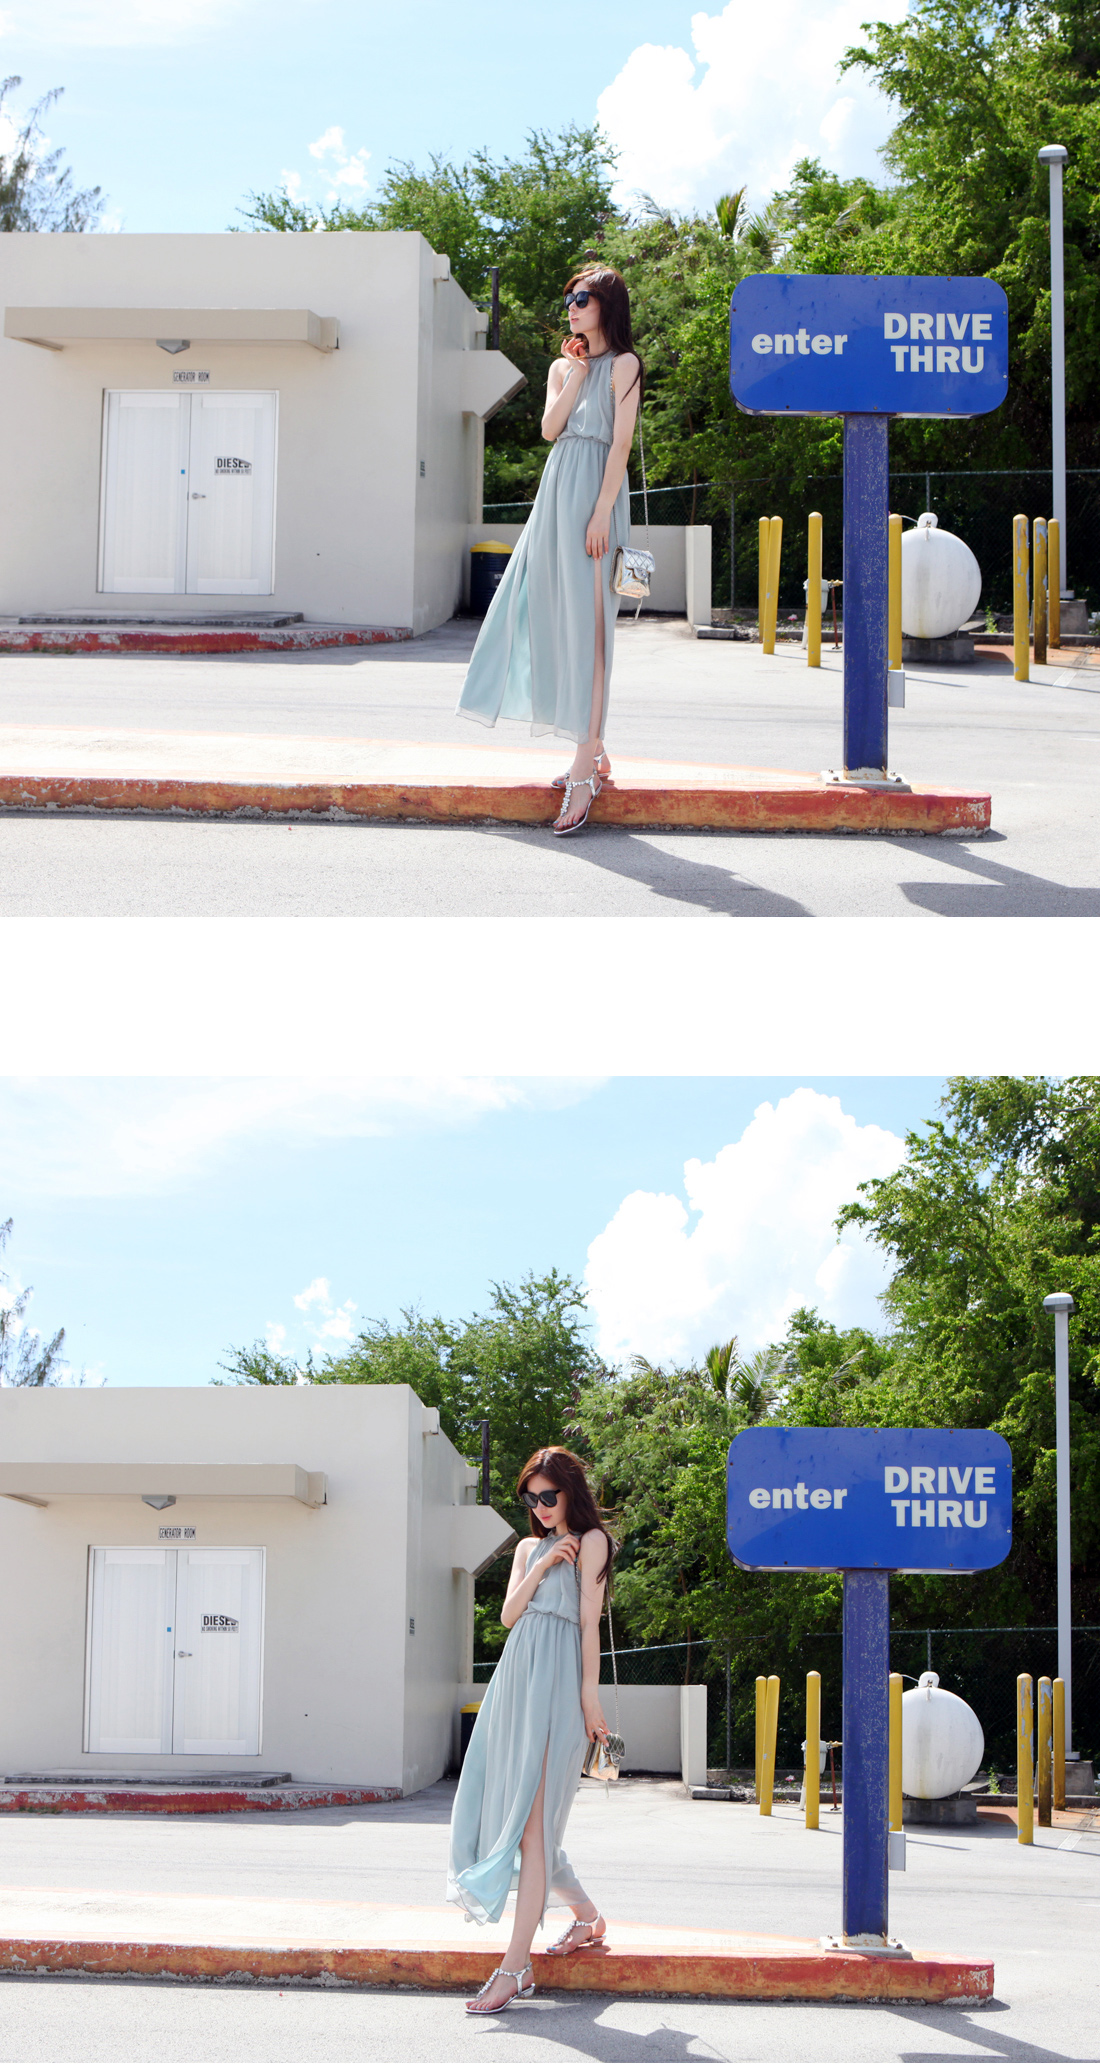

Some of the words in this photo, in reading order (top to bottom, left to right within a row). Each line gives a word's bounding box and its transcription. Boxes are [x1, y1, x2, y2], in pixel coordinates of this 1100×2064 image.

[883, 312, 993, 341] DRIVE
[751, 328, 848, 355] enter
[890, 345, 985, 374] THRU
[173, 371, 196, 382] GENERATOR
[198, 371, 210, 382] ROOM
[884, 1465, 996, 1495] DRIVE
[748, 1482, 848, 1510] enter
[890, 1499, 988, 1529] THRU
[159, 1527, 182, 1538] GENERATOR
[184, 1527, 196, 1538] ROOM
